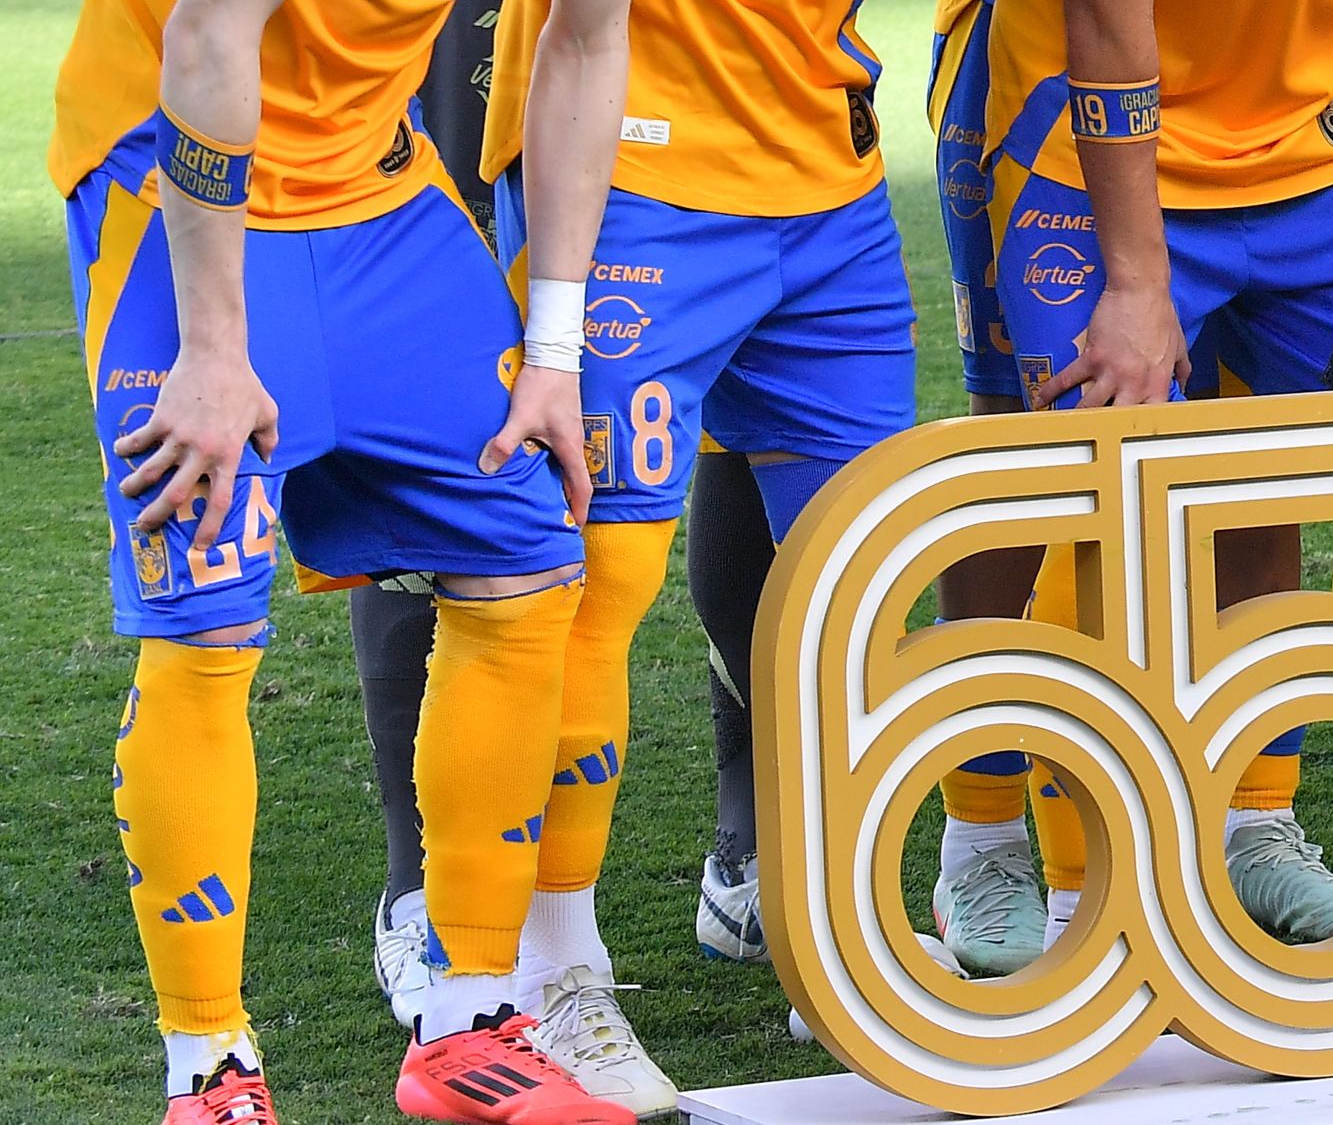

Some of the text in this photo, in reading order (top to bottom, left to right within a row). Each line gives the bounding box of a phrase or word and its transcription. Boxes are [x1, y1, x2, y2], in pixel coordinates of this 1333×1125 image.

[1075, 94, 1108, 136] 19
[954, 129, 986, 146] CEM
[944, 177, 986, 202] Vertua
[1037, 213, 1097, 231] CEME
[594, 264, 664, 285] CEMEX
[122, 370, 171, 390] CEM
[584, 419, 608, 431] RES
[630, 380, 674, 486] 8
